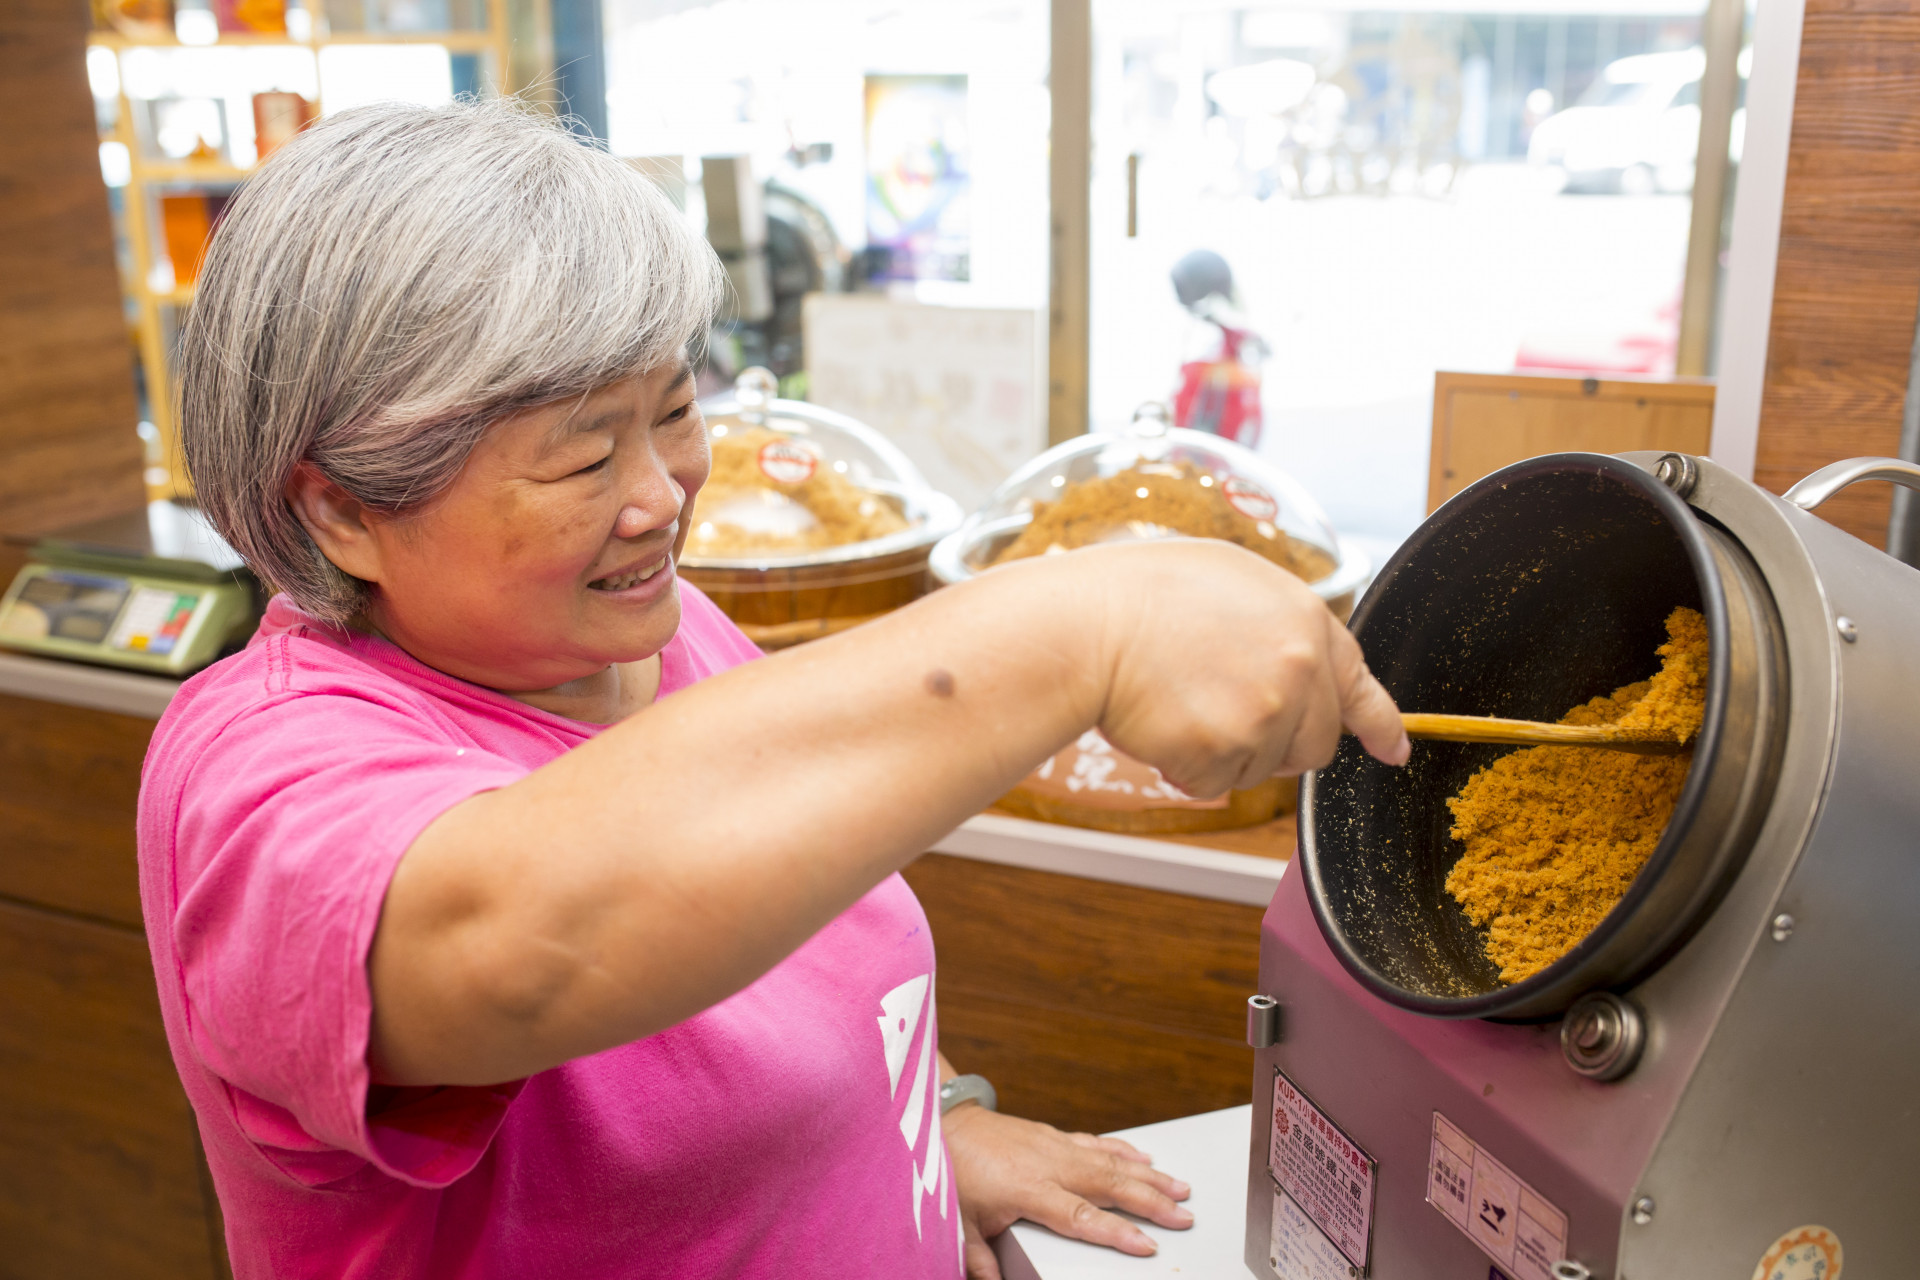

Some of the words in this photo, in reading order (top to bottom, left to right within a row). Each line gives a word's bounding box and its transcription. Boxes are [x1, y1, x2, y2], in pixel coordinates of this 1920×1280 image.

[1293, 1121, 1362, 1204] 金盛號鐵工廠
[1331, 1177, 1344, 1197] IRON
[1345, 1191, 1364, 1218] WORKS
